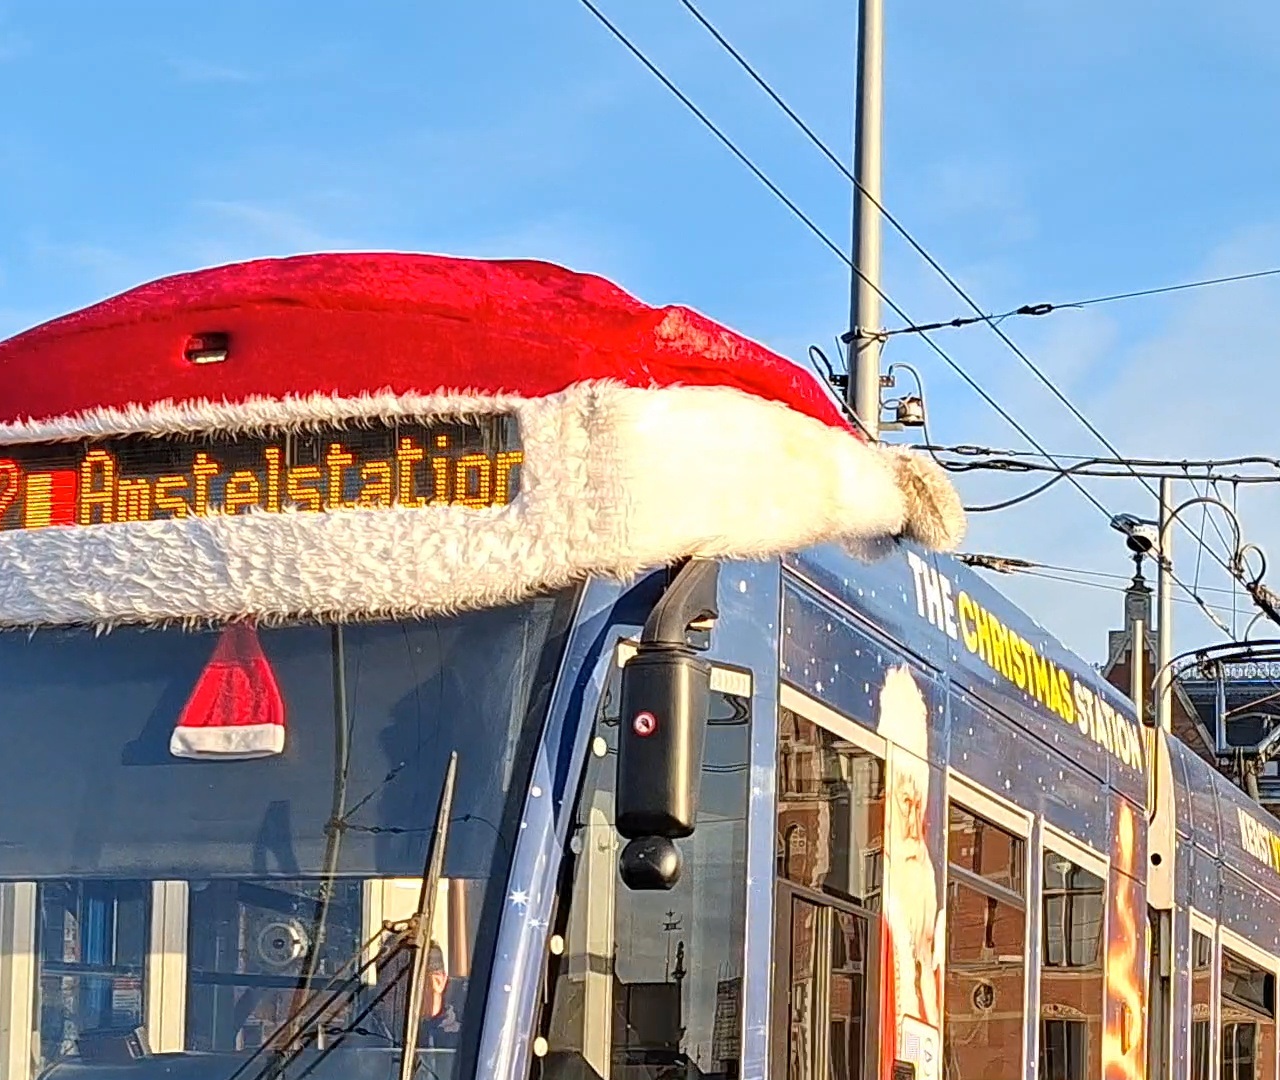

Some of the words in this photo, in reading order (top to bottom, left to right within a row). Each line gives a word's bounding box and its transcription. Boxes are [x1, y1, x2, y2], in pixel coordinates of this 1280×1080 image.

[907, 550, 958, 640] THE
[958, 590, 1074, 724] CHRISTMAS
[1074, 680, 1144, 775] STATION
